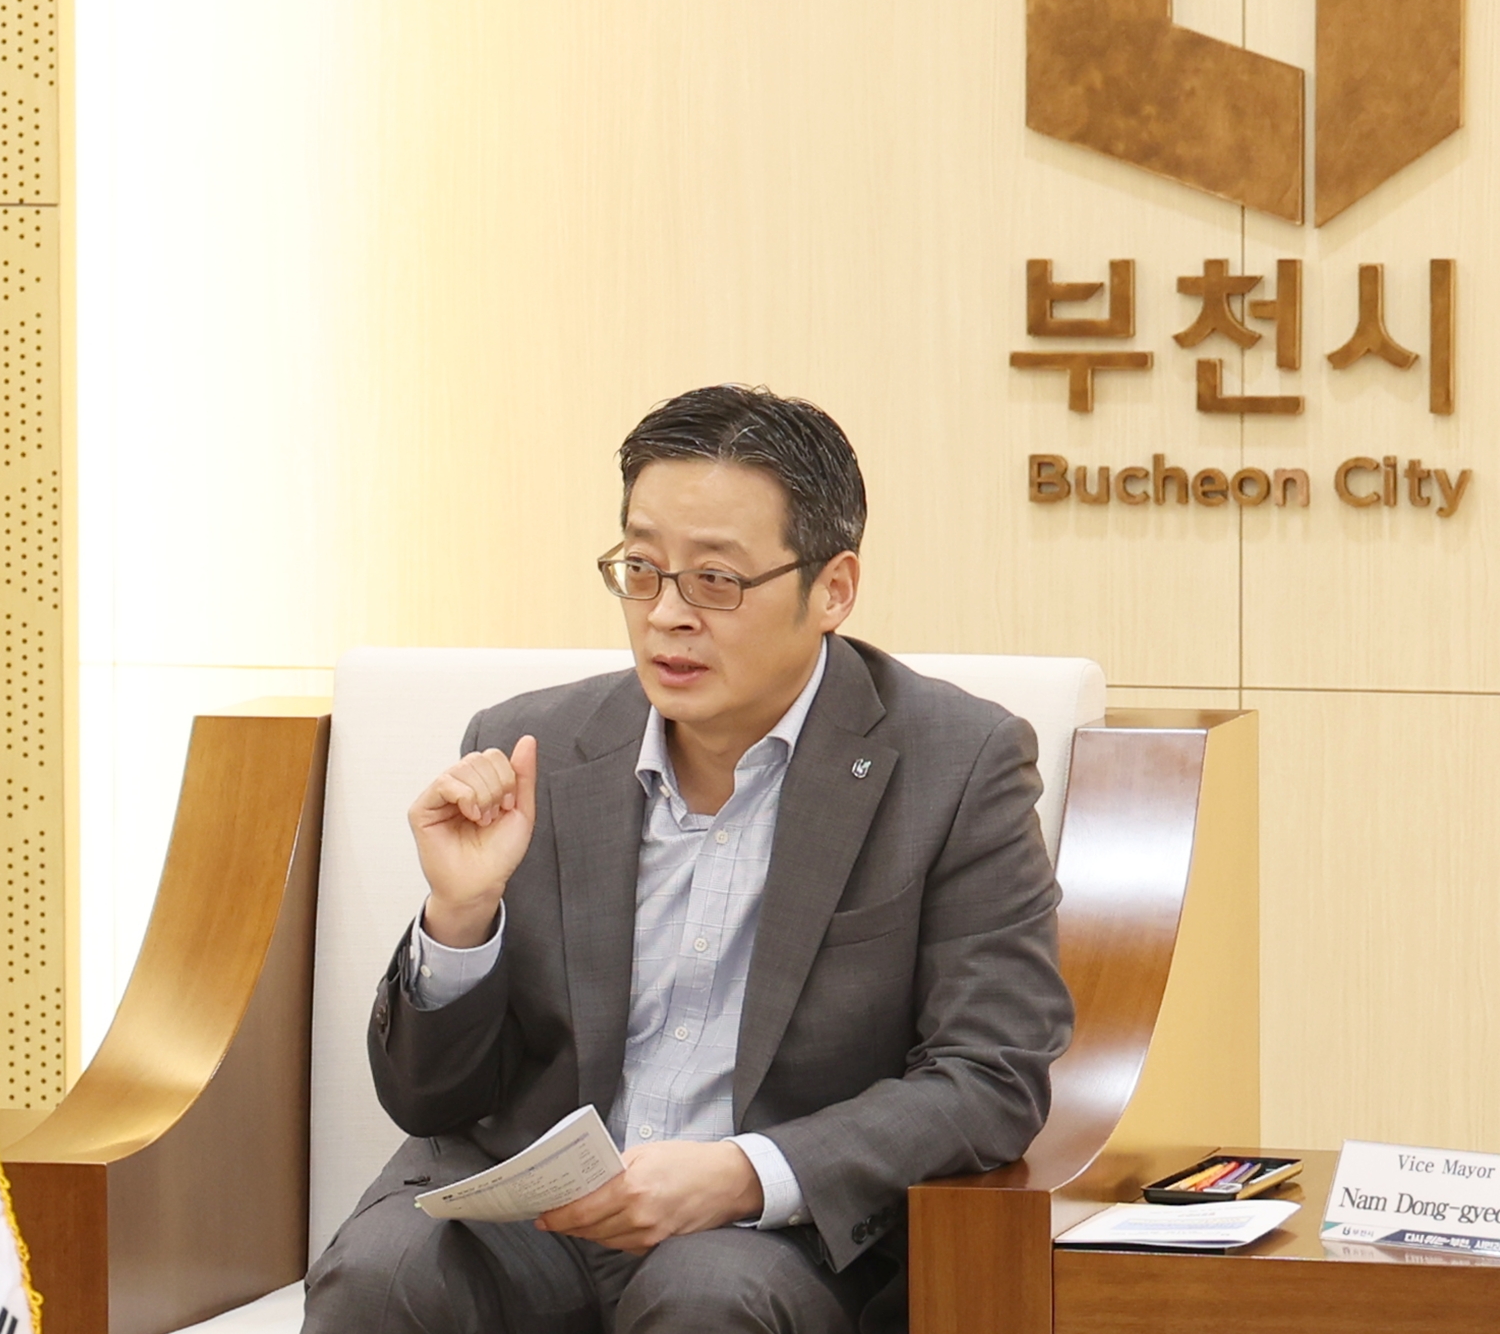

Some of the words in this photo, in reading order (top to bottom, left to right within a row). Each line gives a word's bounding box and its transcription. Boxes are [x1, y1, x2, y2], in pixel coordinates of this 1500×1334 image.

[1010, 258, 1457, 415] 부천시
[1028, 453, 1312, 507] Bucheon
[1334, 454, 1473, 518] City
[1397, 1153, 1436, 1177] Vice
[1441, 1158, 1497, 1182] Mayor
[1337, 1186, 1388, 1215] Nam
